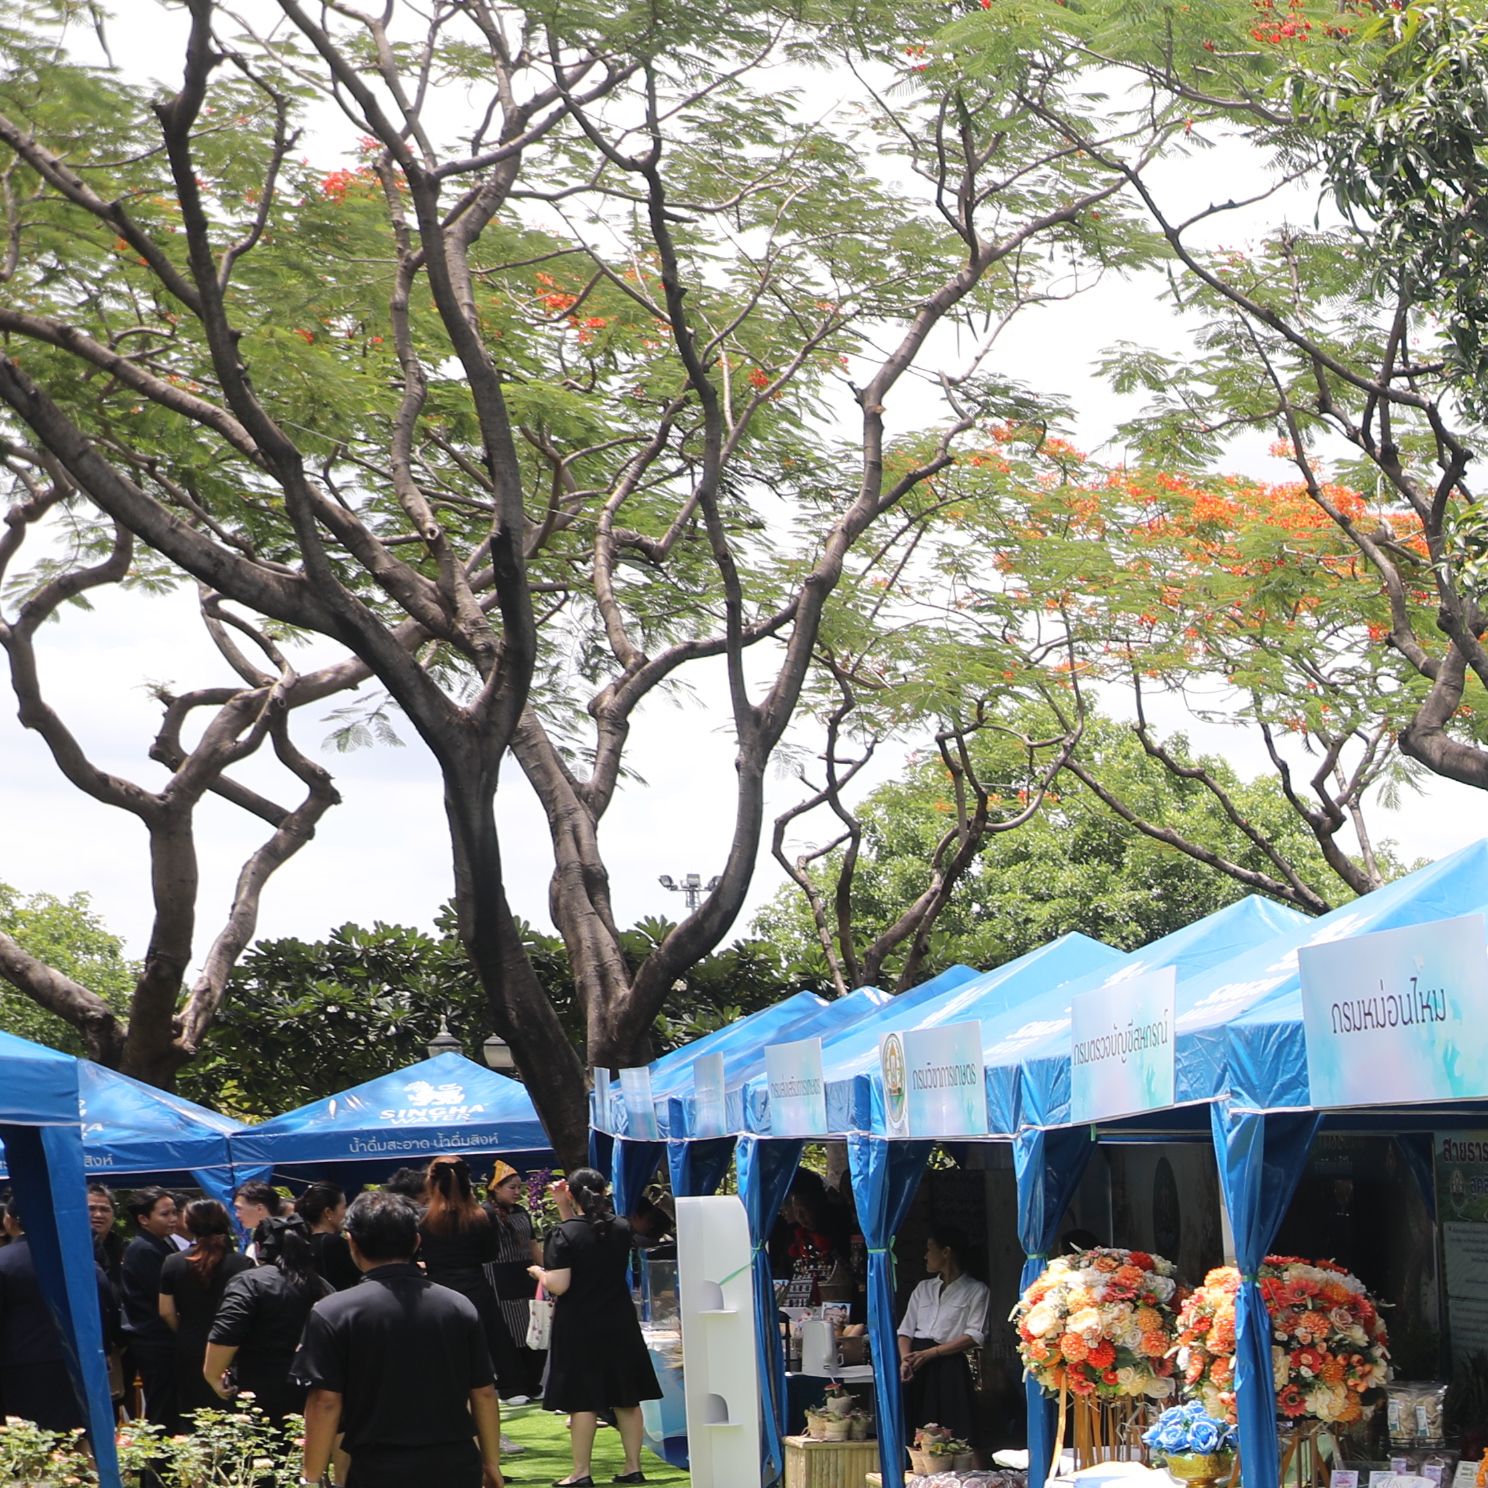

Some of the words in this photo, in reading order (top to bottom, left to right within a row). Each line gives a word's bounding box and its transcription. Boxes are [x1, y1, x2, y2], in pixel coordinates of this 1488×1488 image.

[1330, 976, 1446, 1034] กรมหม่อนไหม
[1073, 1008, 1168, 1066] กรมตรวจบัญชีสหกรณ์
[912, 1062, 977, 1090] กรมวิชาการเกษตร
[379, 1104, 486, 1119] SINGHA
[390, 1113, 472, 1125] WATER
